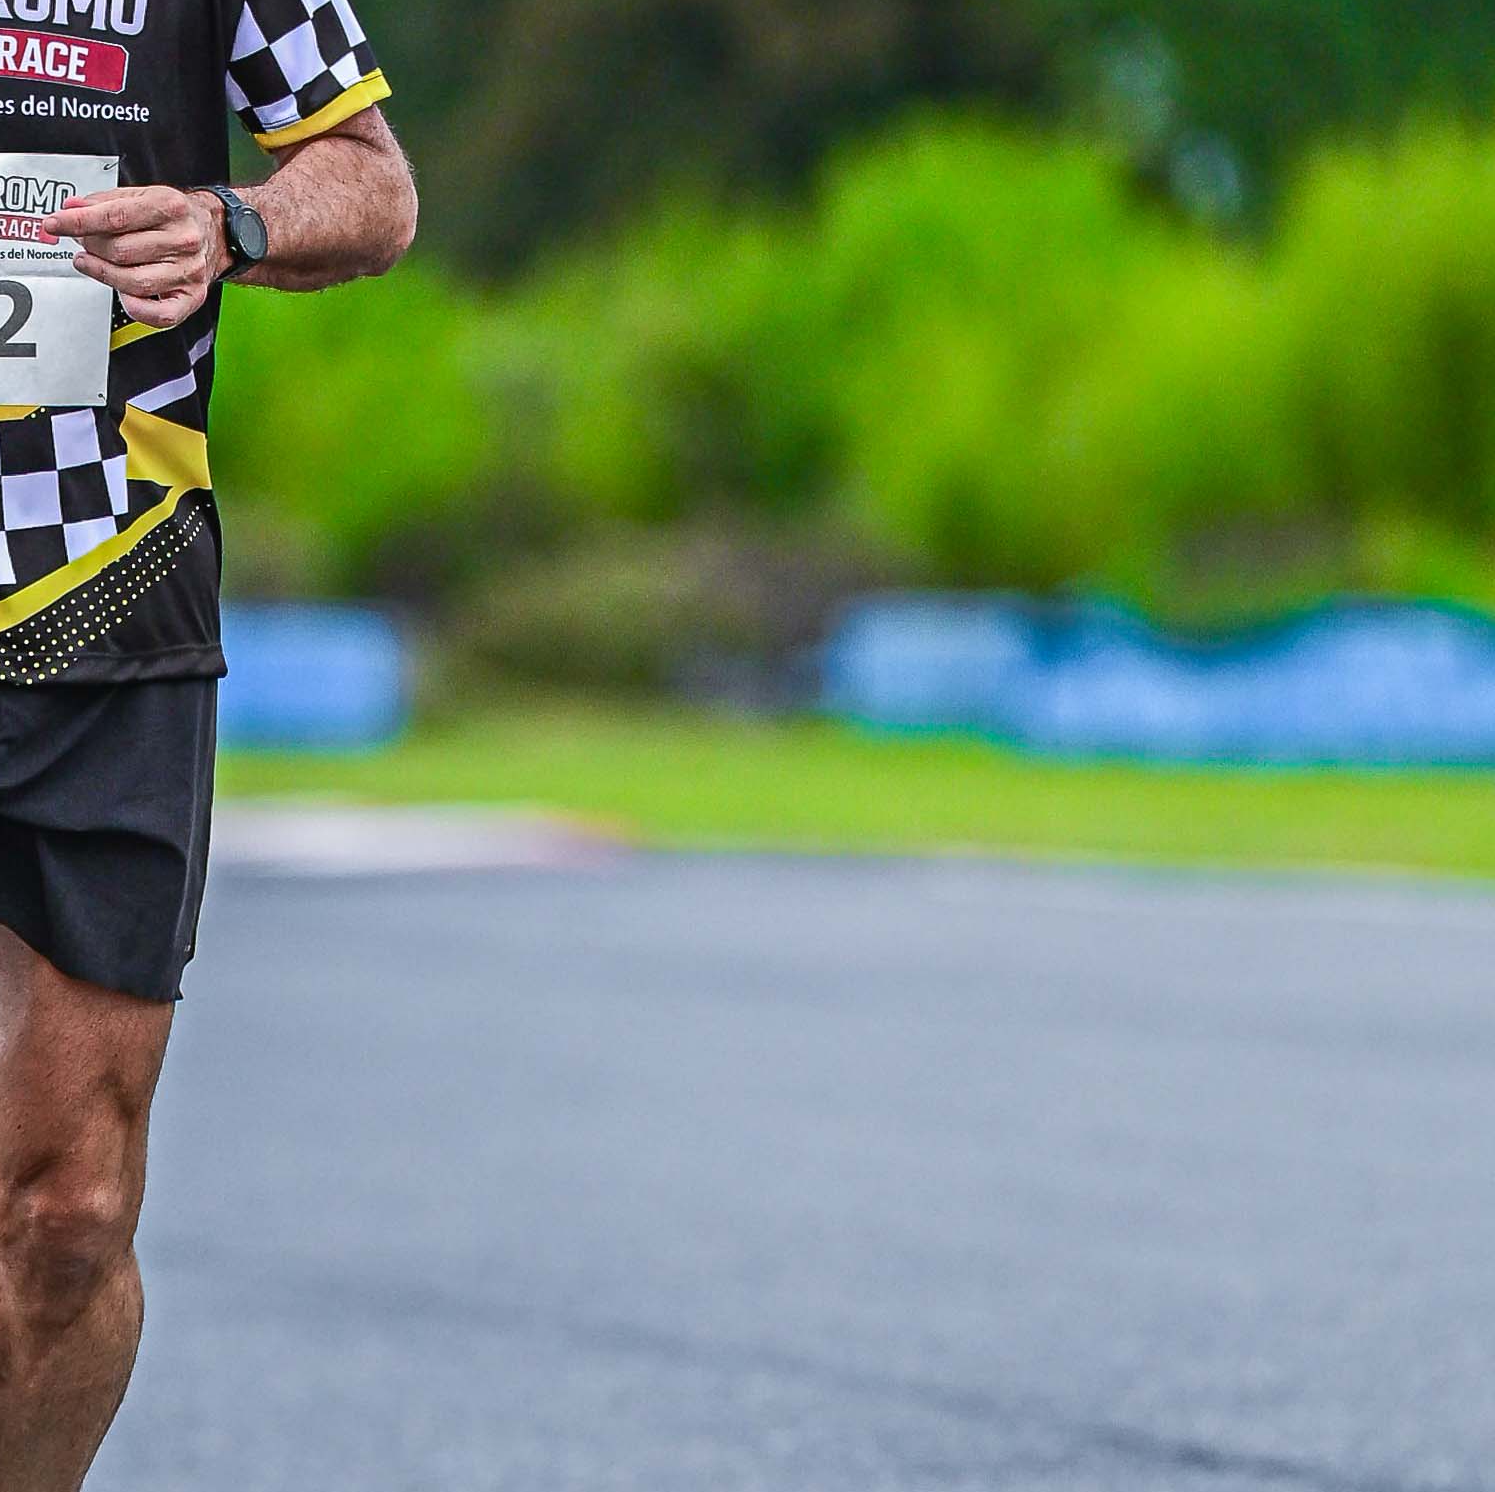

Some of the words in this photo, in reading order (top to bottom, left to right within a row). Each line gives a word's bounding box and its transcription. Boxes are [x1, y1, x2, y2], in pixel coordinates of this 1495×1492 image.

[20, 95, 55, 117] del
[61, 97, 150, 122] Noroeste
[7, 249, 24, 260] del
[26, 250, 74, 260] Noroeste
